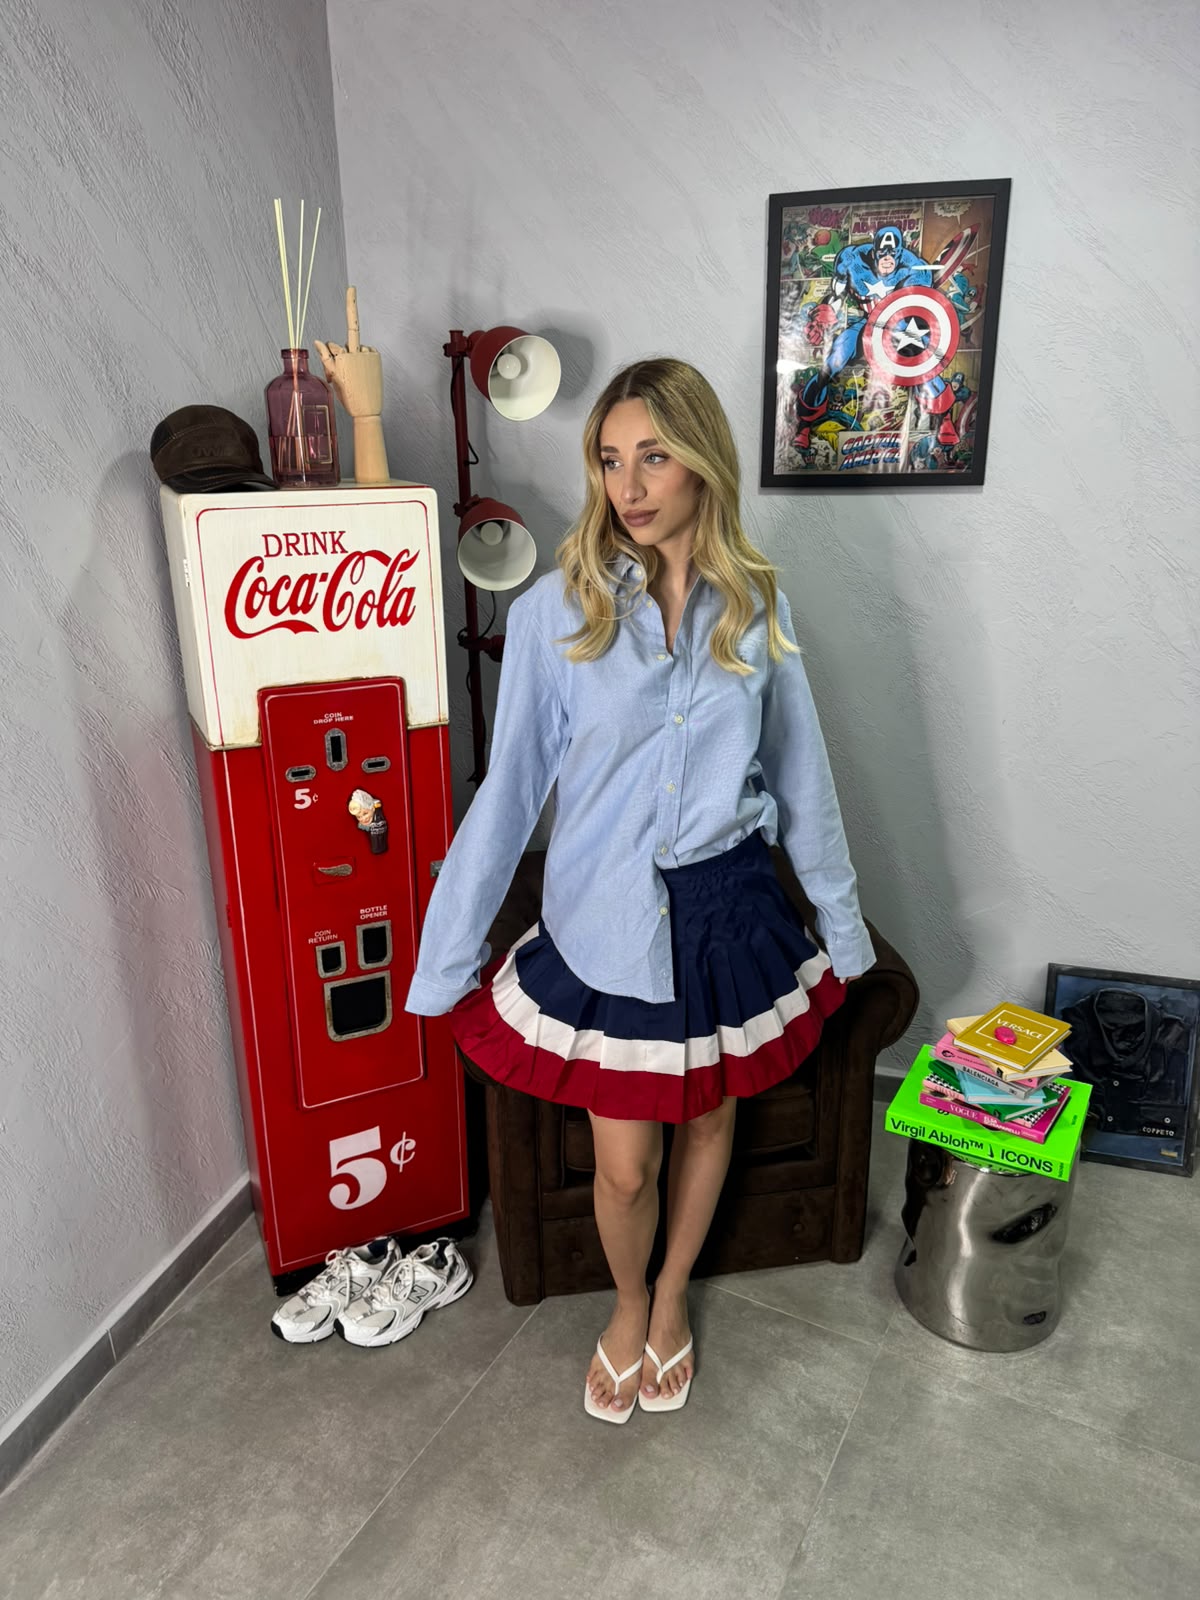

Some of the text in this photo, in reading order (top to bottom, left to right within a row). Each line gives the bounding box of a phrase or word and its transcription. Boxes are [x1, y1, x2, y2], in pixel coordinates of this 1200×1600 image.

[880, 231, 897, 249] A
[262, 530, 348, 558] DRINK
[224, 548, 420, 639] Coca-Cola
[360, 905, 388, 915] BOTTLE
[360, 911, 388, 920] OPENER
[308, 934, 338, 944] RETURN
[314, 929, 331, 937] COIN
[996, 1018, 1046, 1040] VERSACE
[962, 1066, 1000, 1088] BALENCIAGA
[949, 1104, 978, 1120] VOGUE
[890, 1117, 926, 1138] Virgil
[1001, 1148, 1053, 1173] ICONS
[406, 1284, 430, 1304] N
